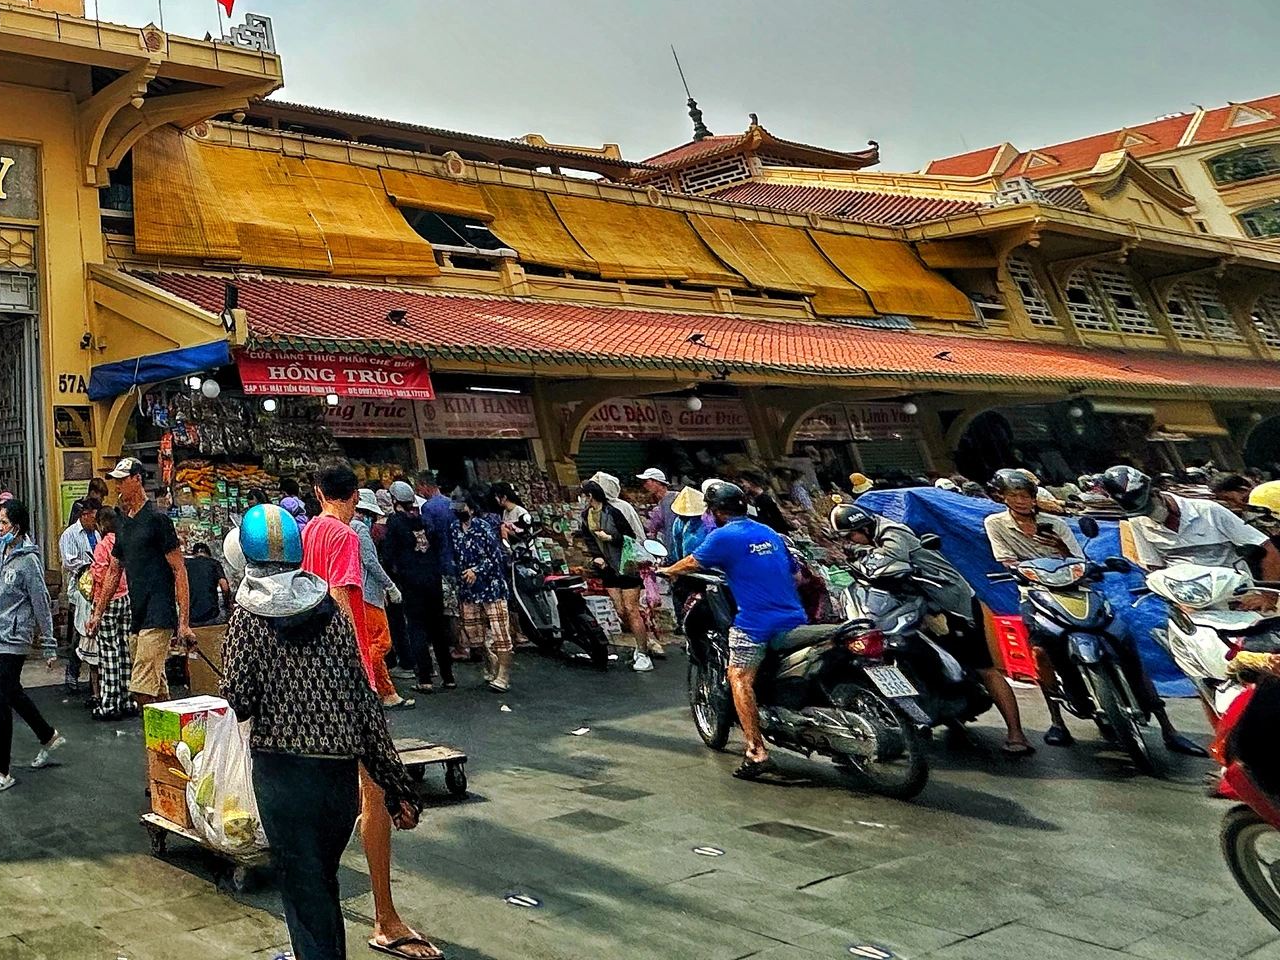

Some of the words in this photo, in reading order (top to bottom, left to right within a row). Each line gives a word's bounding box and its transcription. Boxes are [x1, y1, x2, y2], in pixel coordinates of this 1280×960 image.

[58, 374, 88, 394] 57A
[267, 362, 336, 382] HỒNG
[342, 368, 405, 385] TRÚC
